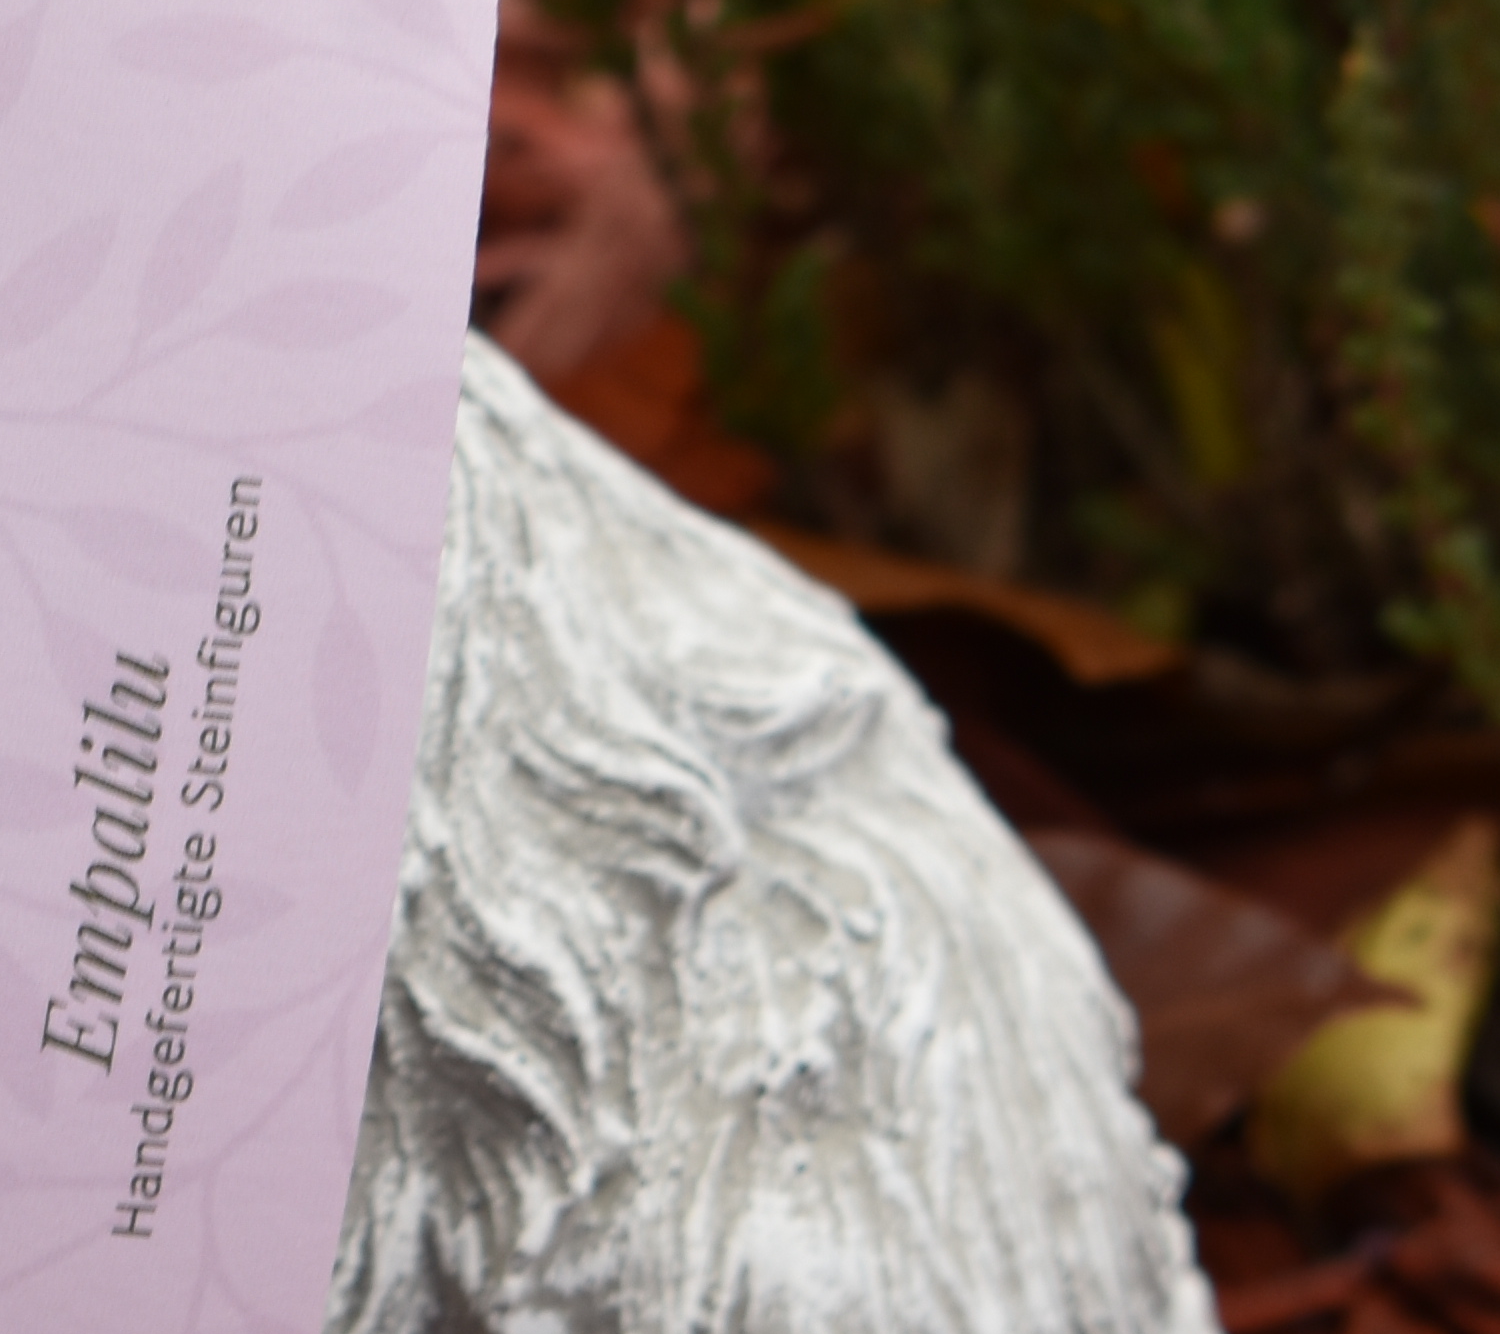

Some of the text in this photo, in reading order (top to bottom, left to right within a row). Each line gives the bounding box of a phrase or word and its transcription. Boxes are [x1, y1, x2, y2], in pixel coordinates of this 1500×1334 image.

[41, 652, 171, 1074] Empalilu
[112, 476, 263, 1239] Handgefertigte Steinfiguren
